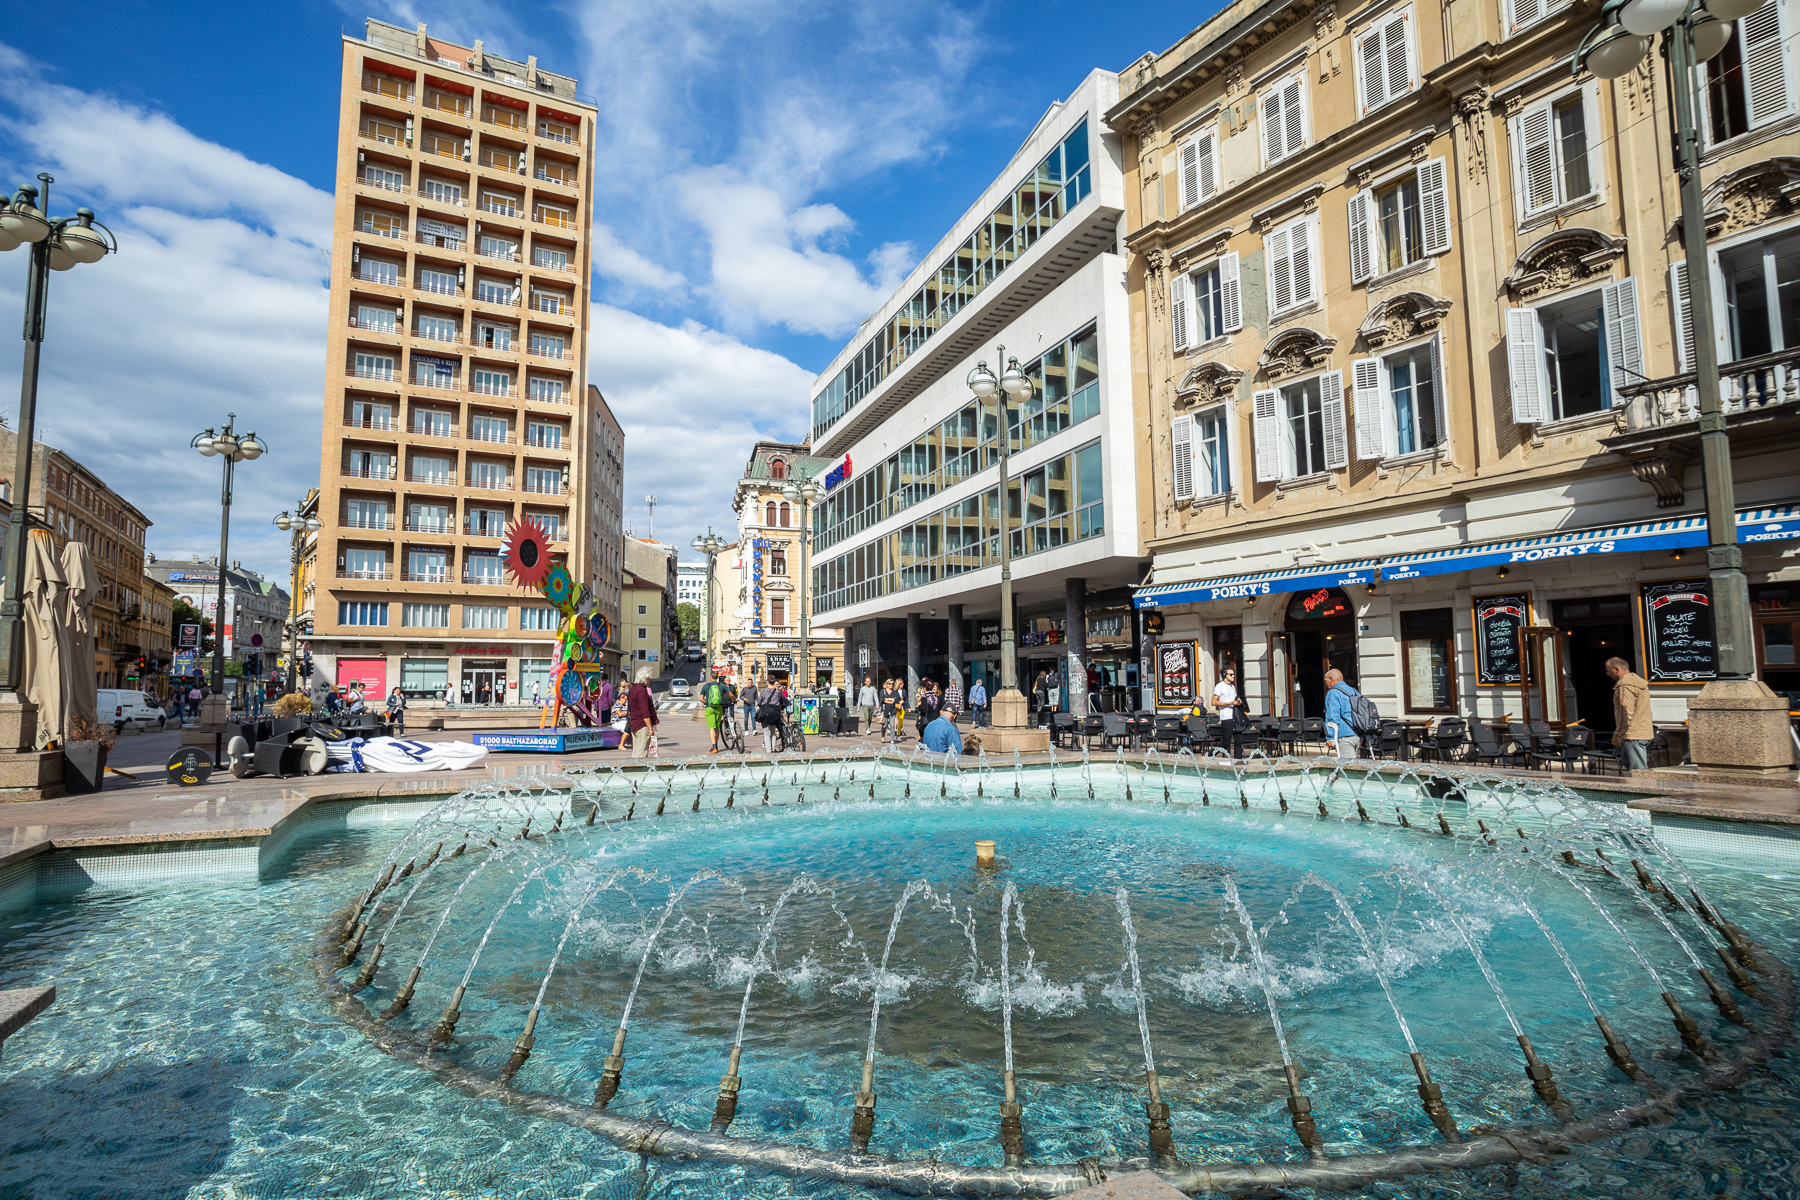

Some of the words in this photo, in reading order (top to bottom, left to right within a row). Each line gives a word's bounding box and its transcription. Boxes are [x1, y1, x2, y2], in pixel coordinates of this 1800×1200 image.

[1745, 530, 1800, 542] PORKY'S
[752, 538, 771, 548] HOTEL
[1509, 540, 1616, 563] PORKY'S
[1389, 570, 1420, 580] PORKY'S
[1338, 577, 1366, 586] PORKY'S
[753, 550, 762, 626] BONAVIA
[1211, 582, 1270, 600] PORKY'S
[454, 646, 488, 655] Addiko
[489, 647, 513, 656] Bank
[566, 735, 586, 744] RIJEKA
